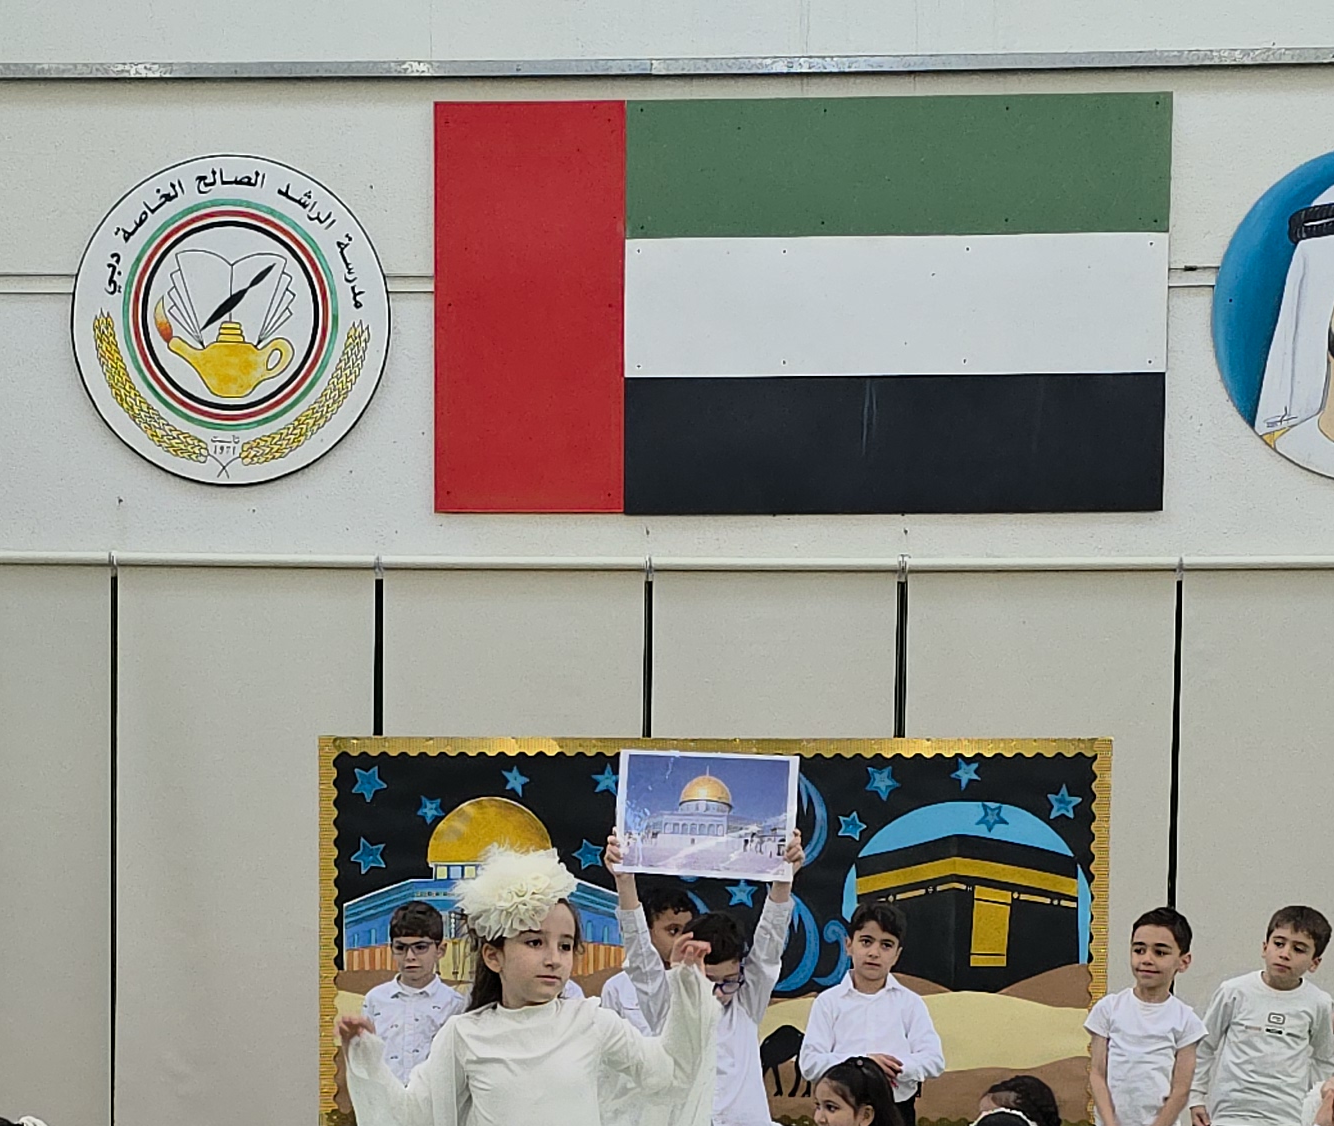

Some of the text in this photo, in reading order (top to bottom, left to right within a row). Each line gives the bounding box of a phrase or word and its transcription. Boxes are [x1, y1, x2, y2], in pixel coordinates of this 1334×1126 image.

[104, 167, 366, 310] مدرسة الراشد الصالح الخاصة دبي
